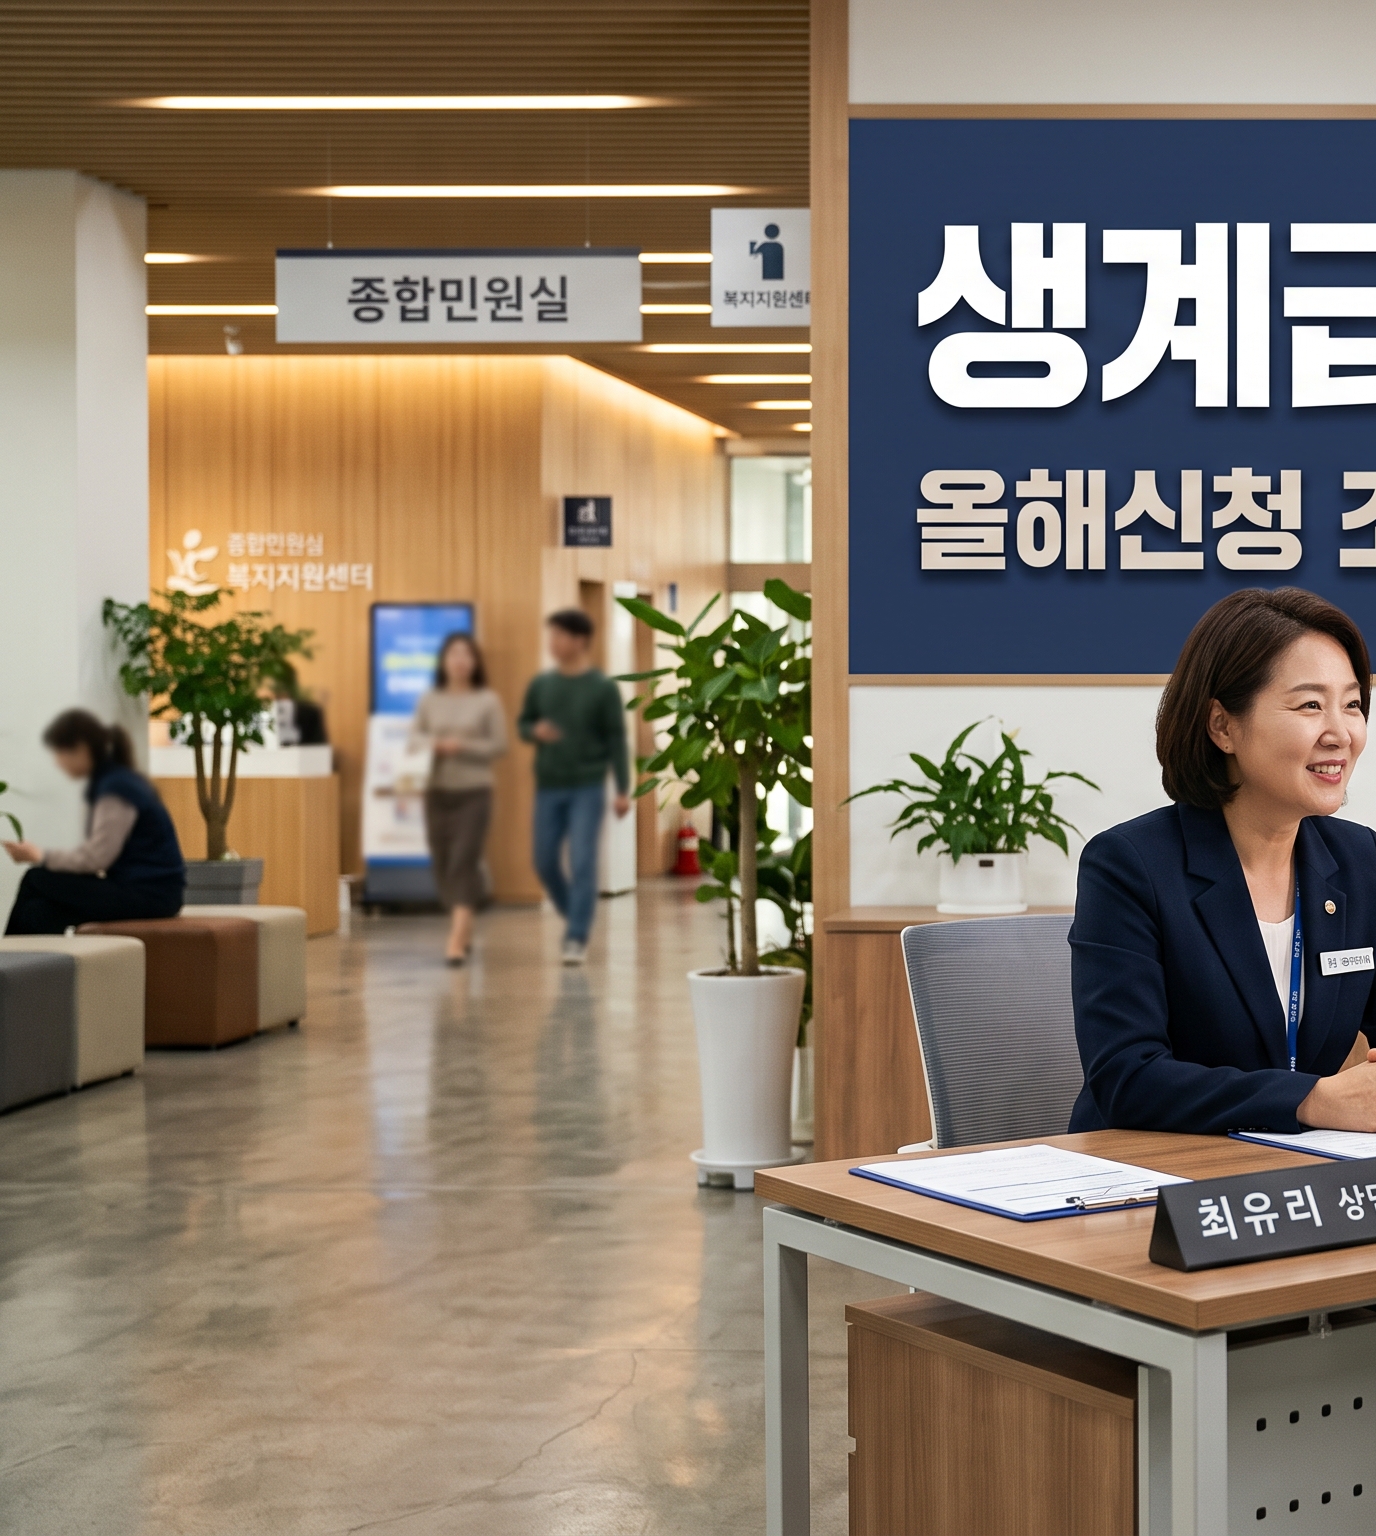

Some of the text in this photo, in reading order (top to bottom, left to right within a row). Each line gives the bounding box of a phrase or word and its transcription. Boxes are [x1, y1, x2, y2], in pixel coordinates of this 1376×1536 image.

[347, 275, 568, 323] 종합민원실
[916, 467, 1303, 571] 올해신청
[226, 562, 374, 592] 복지지원센터
[1198, 1185, 1322, 1240] 최유리
